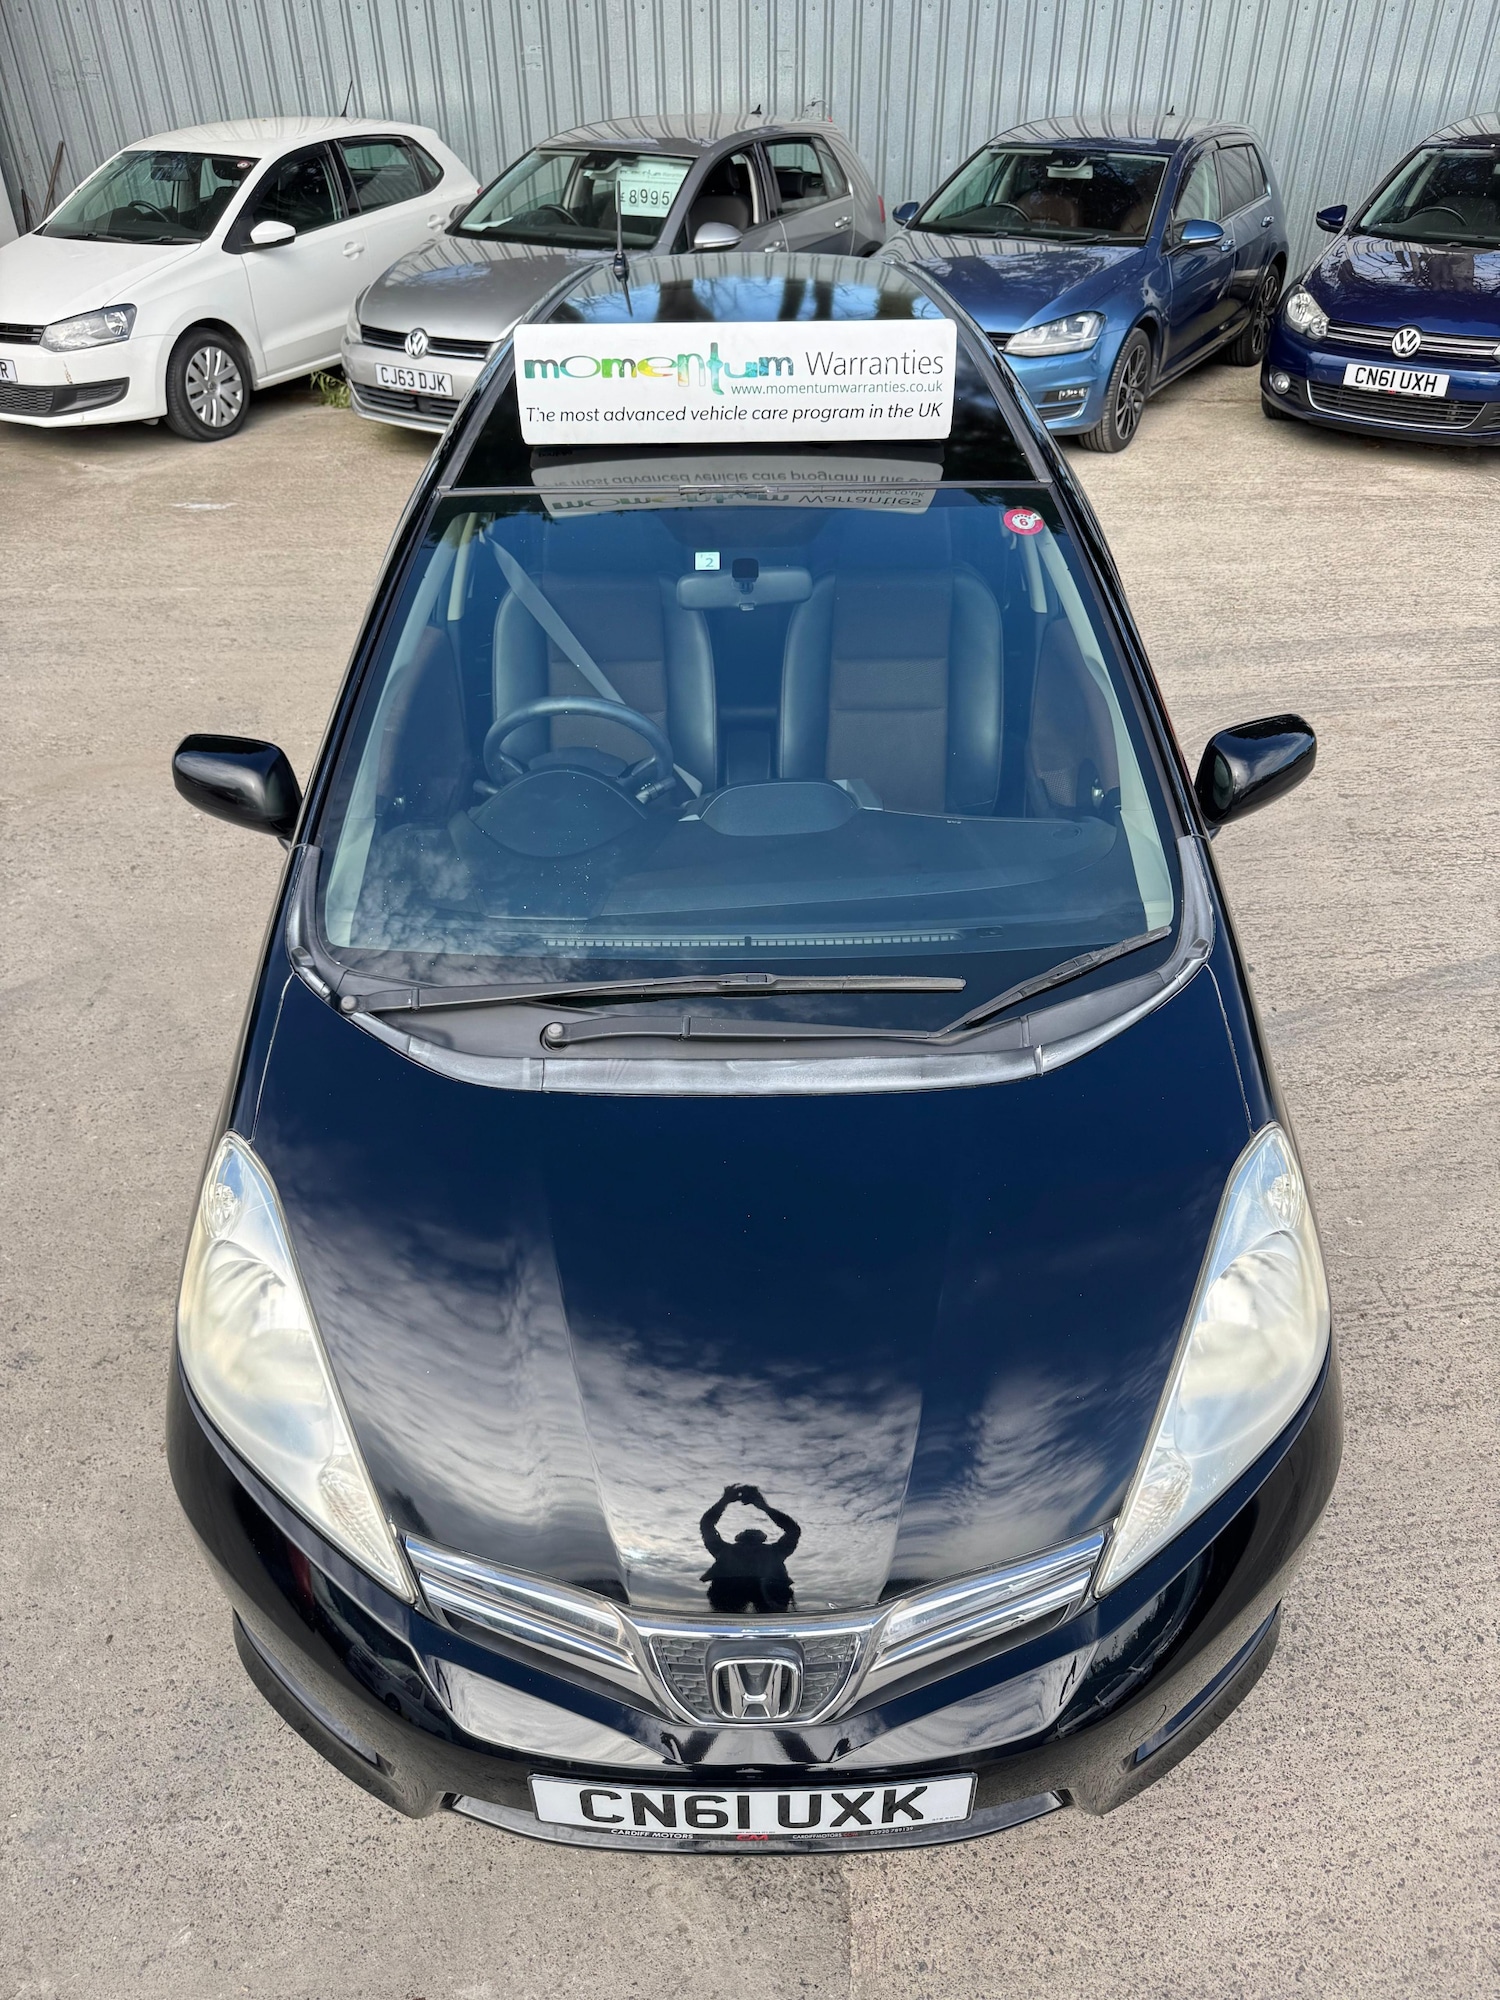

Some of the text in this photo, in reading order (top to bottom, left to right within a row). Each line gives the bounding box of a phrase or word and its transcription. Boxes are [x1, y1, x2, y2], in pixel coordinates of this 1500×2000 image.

[381, 367, 447, 392] CJ63 DJK
[524, 342, 943, 395] momentum Warranties
[1355, 367, 1438, 393] CN61 UXH
[731, 380, 943, 395] www.momentumwarranties.co.uk
[526, 402, 943, 423] The most advanced vehicle care program in the UK
[706, 557, 714, 568] 2
[579, 1785, 928, 1829] CN61 UXK
[611, 1829, 694, 1840] CARDIFF MOTORS
